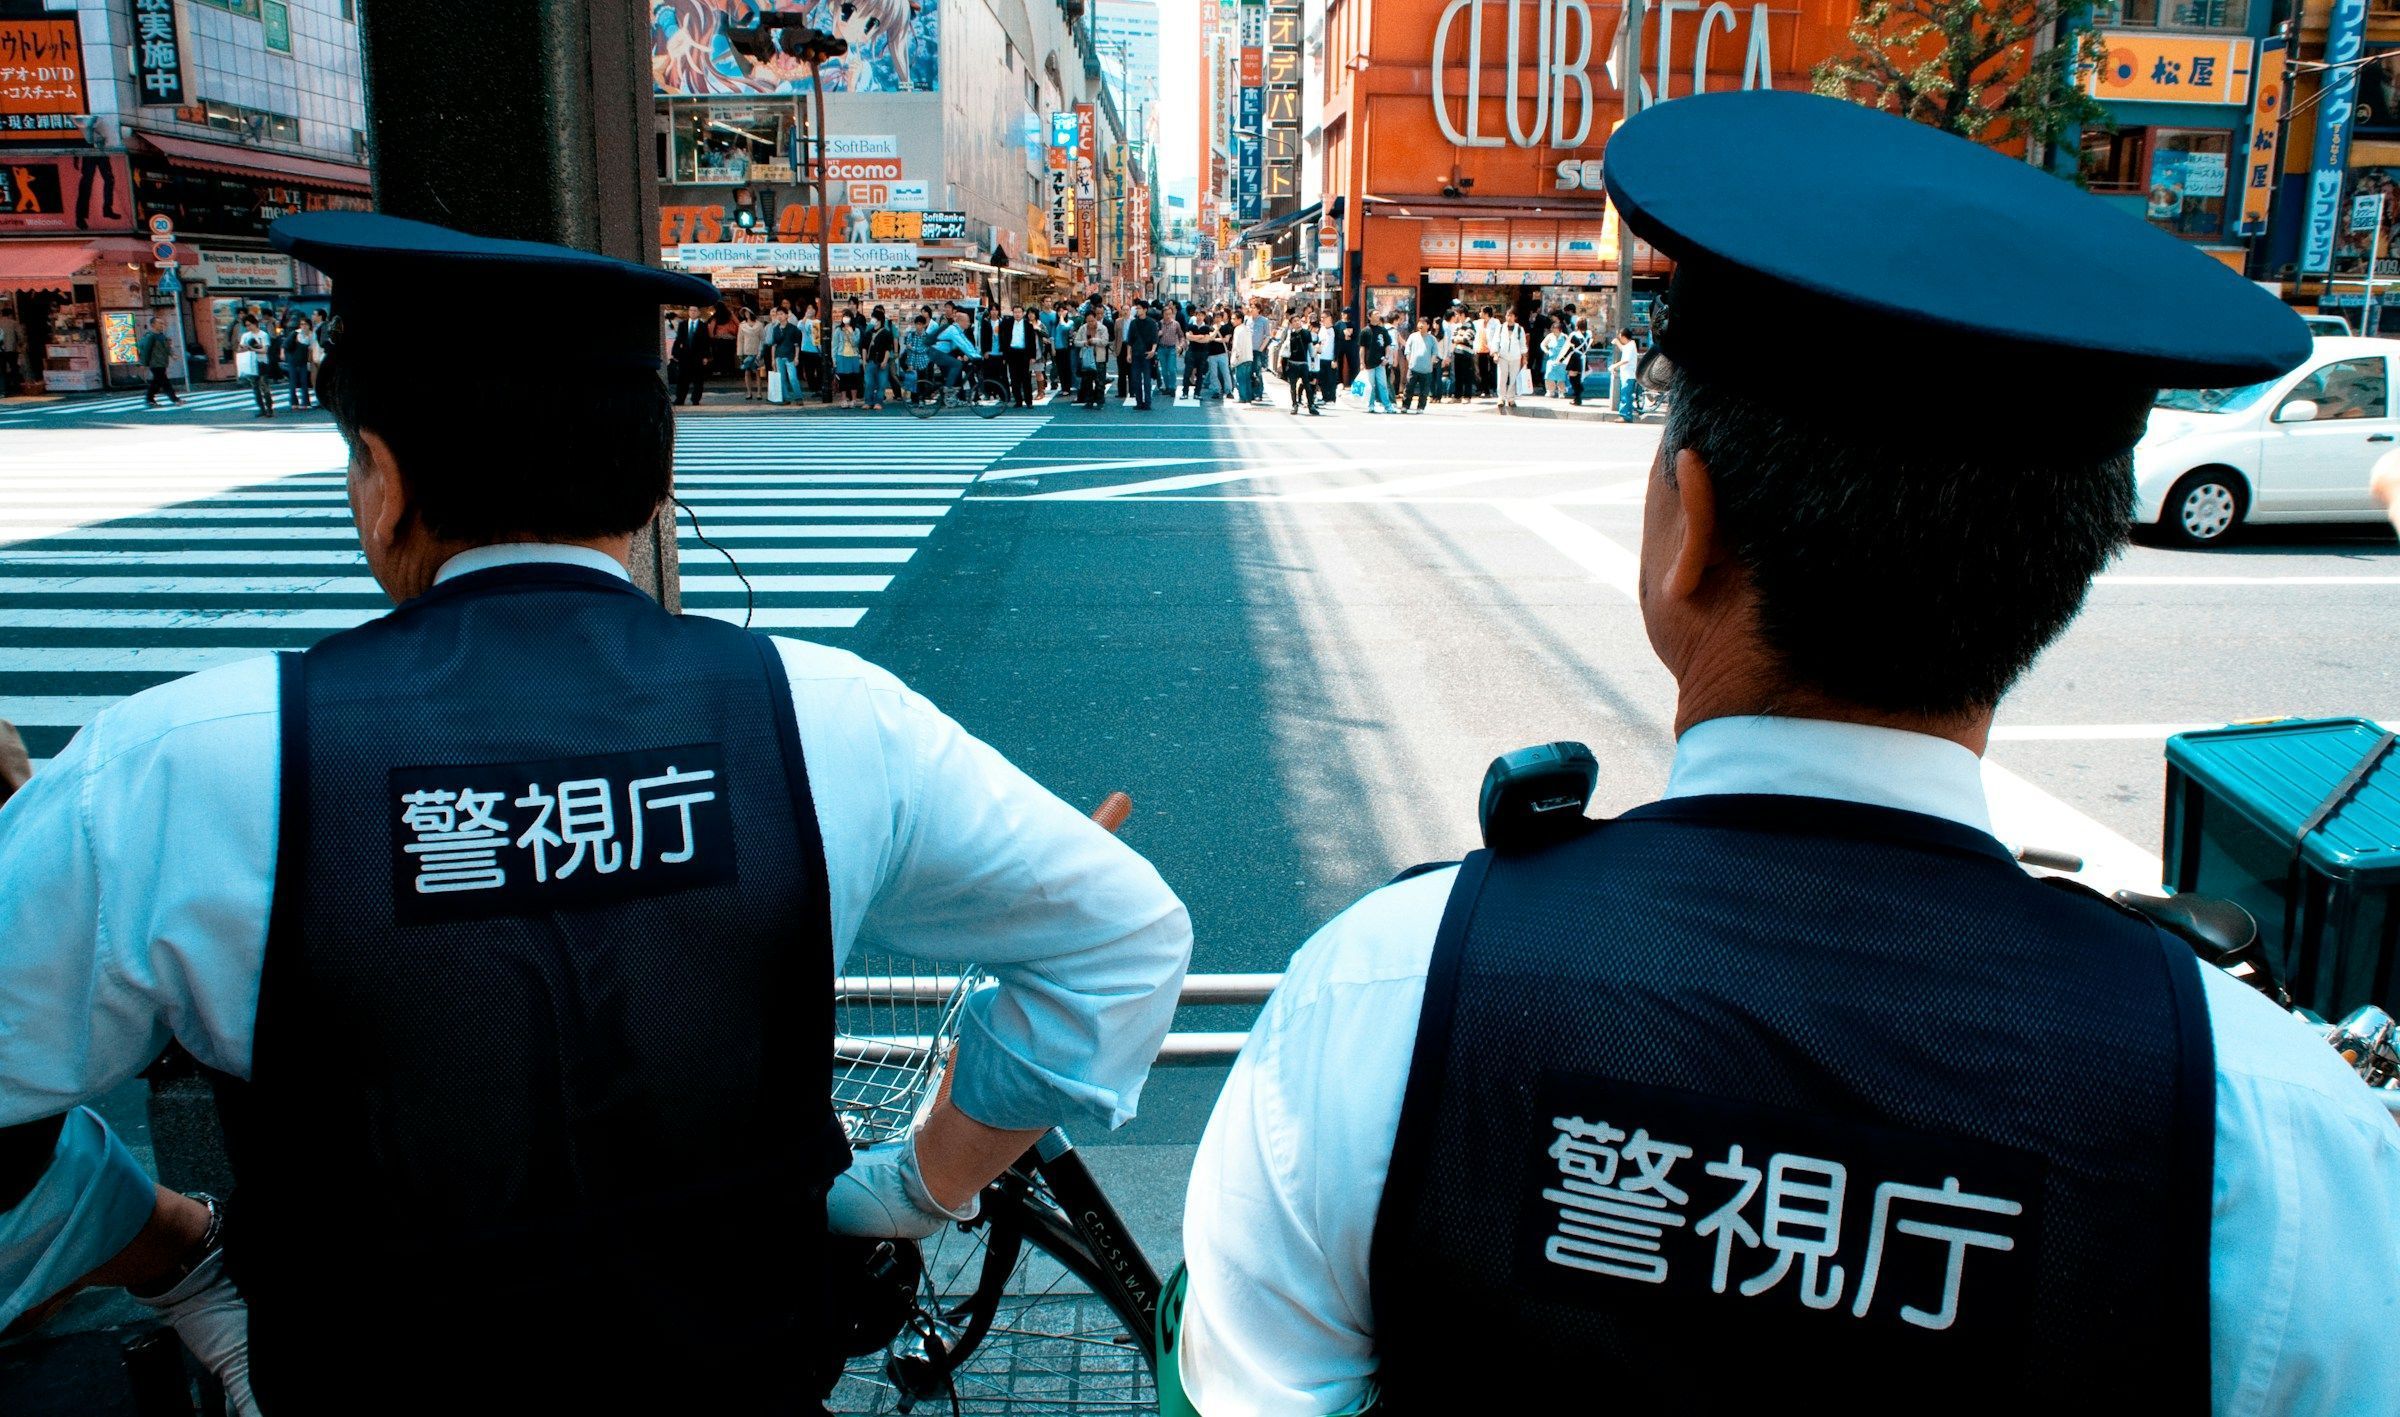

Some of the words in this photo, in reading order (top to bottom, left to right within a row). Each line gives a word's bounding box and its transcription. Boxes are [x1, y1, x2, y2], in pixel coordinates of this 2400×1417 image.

[1, 29, 71, 62] ウトレット
[0, 67, 75, 82] デオ・DVD
[1432, 0, 1593, 149] CLUB
[2150, 55, 2216, 87] 松屋
[0, 85, 77, 100] ・コスチューム
[1270, 0, 1296, 194] オデパート
[1078, 111, 1093, 151] KFC
[834, 139, 891, 154] SoftBank
[2251, 128, 2273, 188] 松屋
[1556, 159, 1603, 190] SE
[155, 219, 170, 230] 20
[2308, 181, 2338, 267] ソフマップ
[1472, 240, 1497, 250] SEGA
[1568, 241, 1593, 250] SEGA
[203, 253, 233, 263] Welcome
[700, 248, 753, 261] SoftBank
[774, 248, 820, 261] SoftBan
[853, 248, 912, 261] SoftBank
[218, 275, 247, 286] Inquiries
[401, 765, 716, 894] 警視庁
[1542, 1116, 2023, 1331] 警視庁
